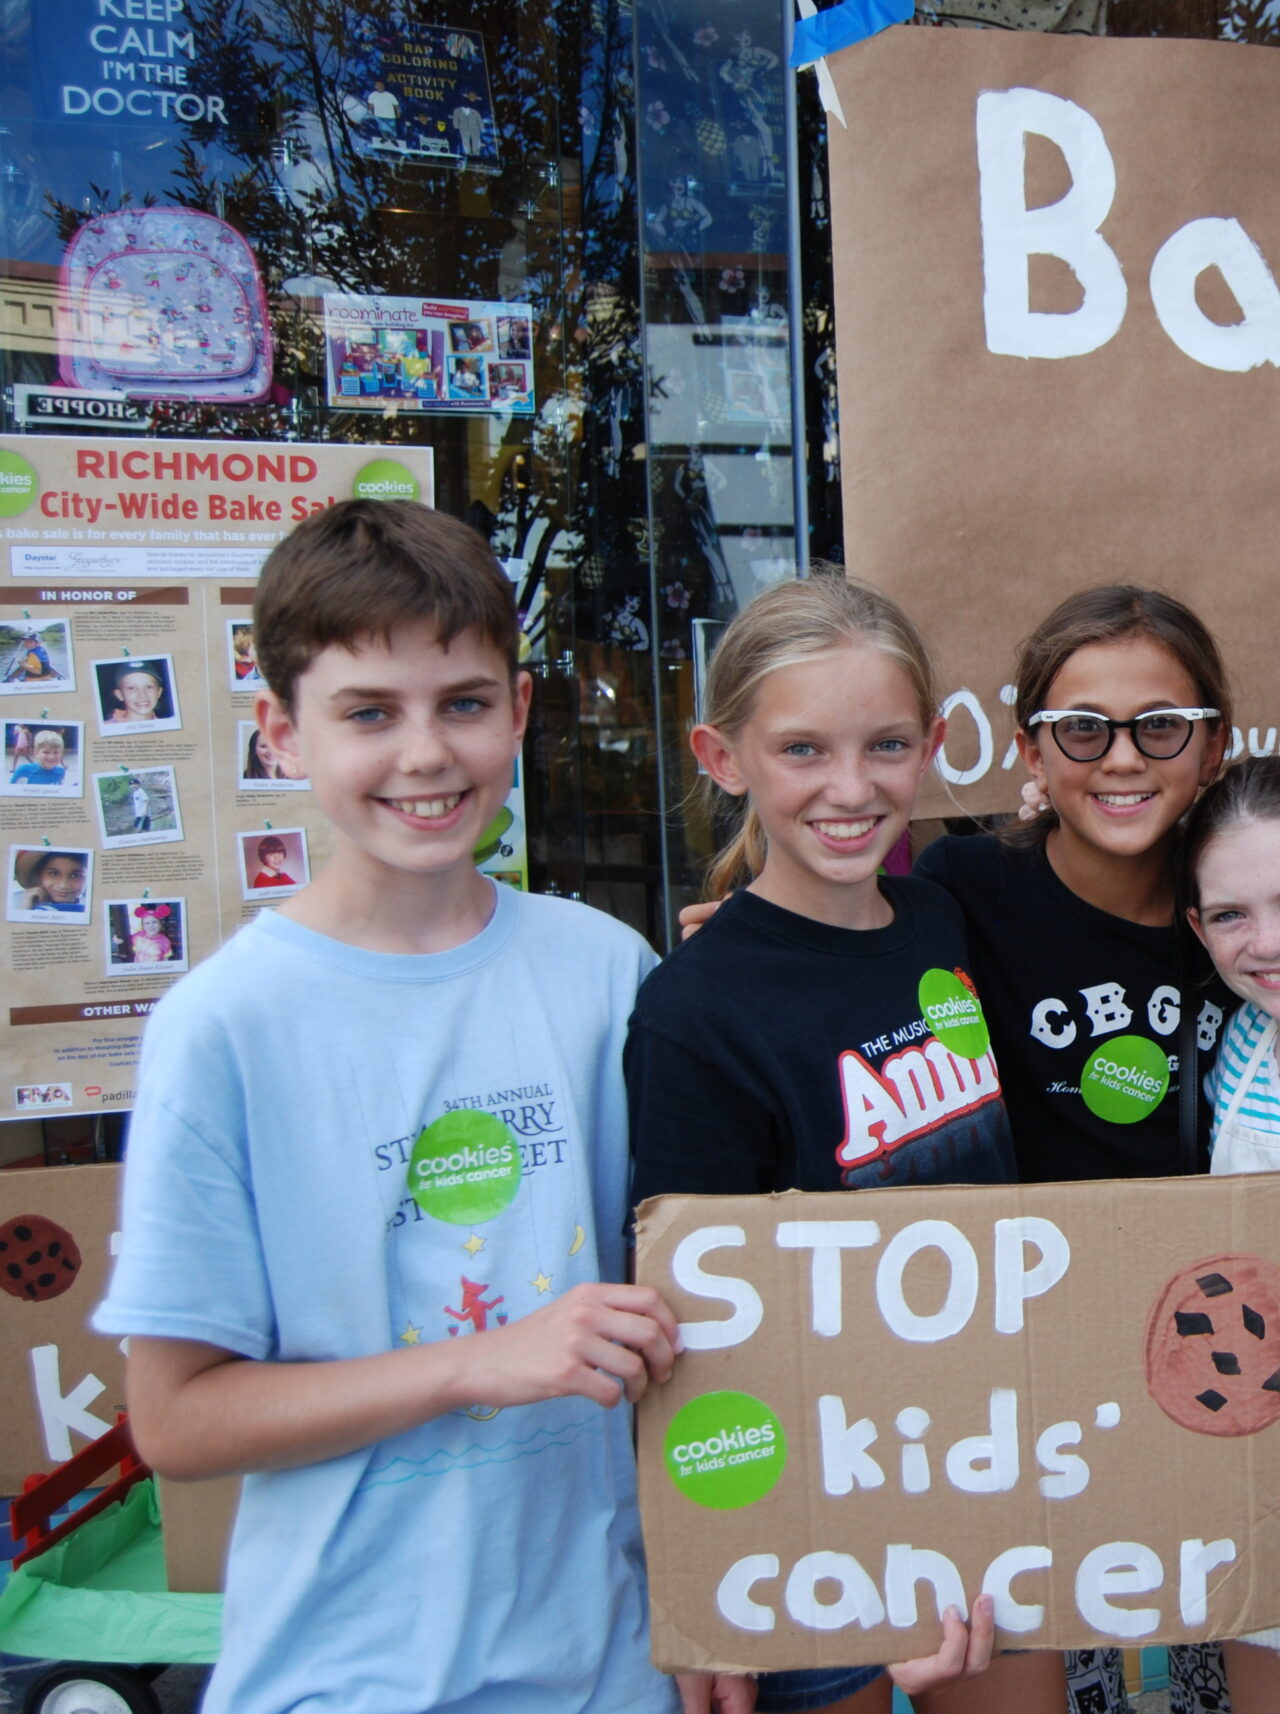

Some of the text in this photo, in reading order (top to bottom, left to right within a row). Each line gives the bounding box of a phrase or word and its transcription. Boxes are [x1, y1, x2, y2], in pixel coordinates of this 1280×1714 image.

[100, 0, 184, 22] KEEP
[90, 25, 196, 60] CALM
[403, 43, 433, 56] RAP
[382, 53, 458, 71] COLORING
[103, 61, 188, 86] I'M THE
[387, 72, 457, 90] ACTIVITY
[404, 87, 445, 101] BOOK
[63, 86, 229, 125] DOCTOR
[328, 304, 419, 323] roominate
[77, 449, 318, 483] RICHMOND
[0, 471, 32, 485] kies
[359, 480, 414, 493] cookies
[40, 491, 335, 524] City-Wide Bake Sal
[6, 527, 276, 543] bake sale is for every family that has ever
[42, 591, 137, 600] IN HONOR OF
[84, 1001, 156, 1017] OTHER WA
[926, 996, 977, 1020] cookies
[861, 1018, 933, 1058] THE MUSIC
[1093, 1057, 1164, 1093] cookies
[443, 1083, 553, 1113] 34TH ANNUAL
[1046, 1081, 1082, 1094] Hom
[1123, 1085, 1157, 1103] cancer
[416, 1143, 513, 1177] cookies
[466, 1164, 513, 1183] cancer
[673, 1216, 1071, 1351] STOP
[672, 1425, 776, 1463] cookies
[818, 1386, 1122, 1500] kids'
[728, 1445, 776, 1466] cancer
[717, 1537, 1236, 1639] cancer
